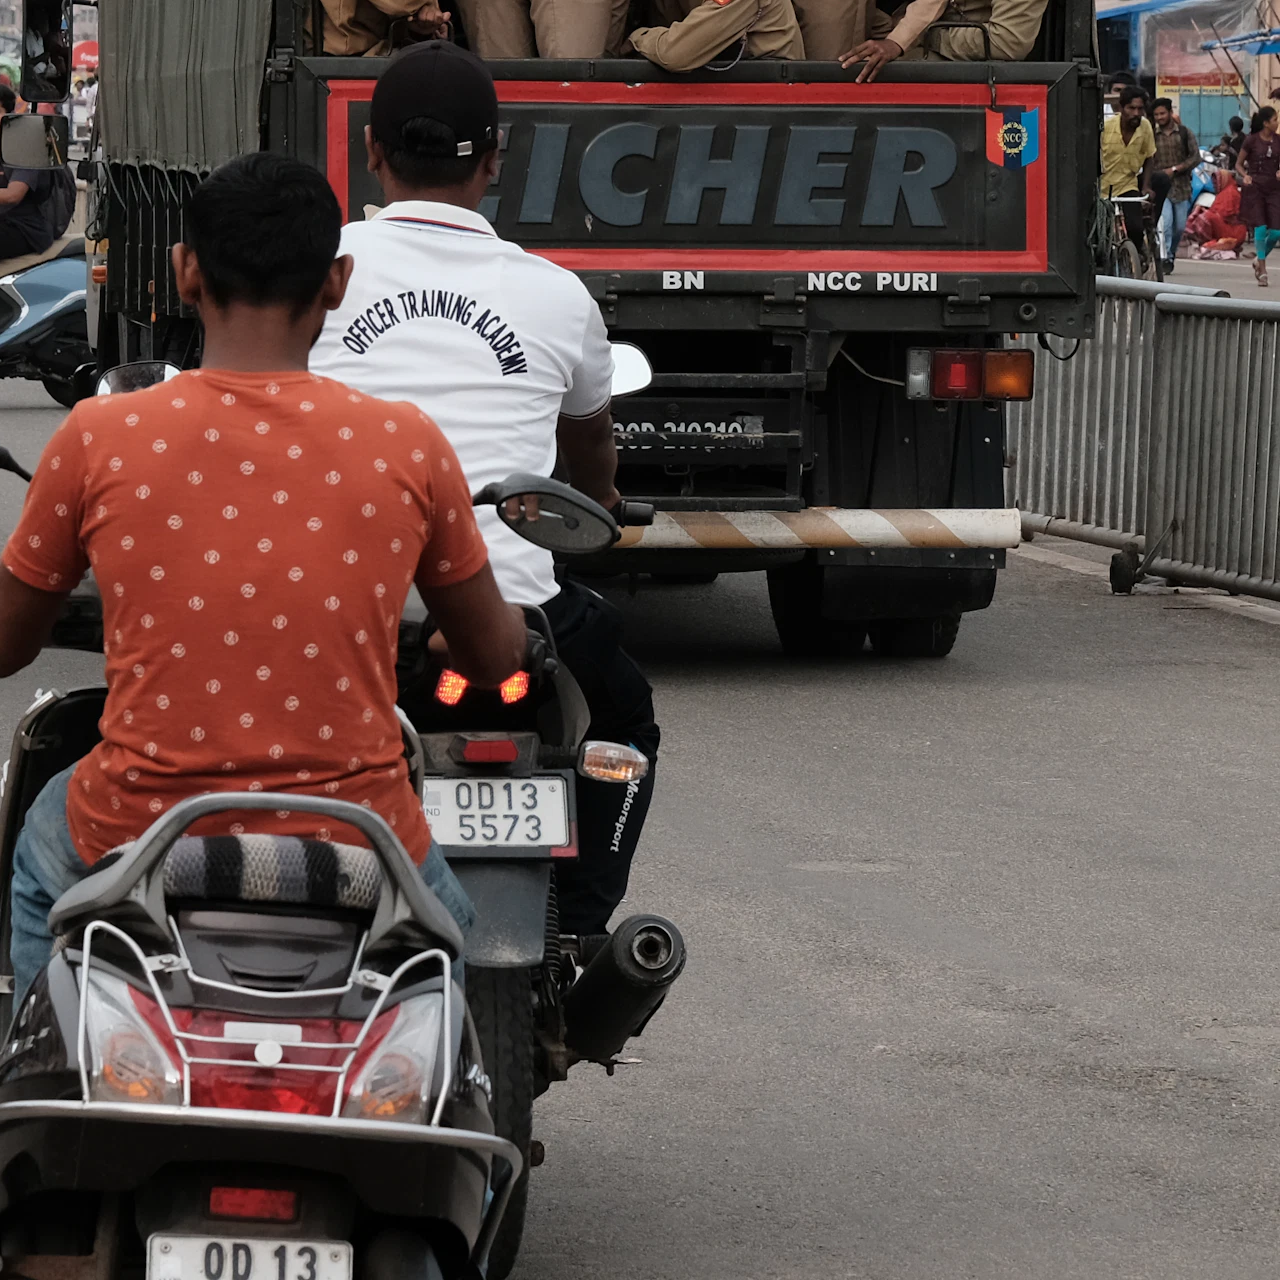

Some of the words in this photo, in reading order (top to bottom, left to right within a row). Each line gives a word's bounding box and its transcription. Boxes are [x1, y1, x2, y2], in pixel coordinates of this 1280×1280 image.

[1003, 133, 1023, 143] NCC
[662, 271, 705, 290] BN
[807, 272, 862, 291] NCC
[876, 272, 938, 291] PURI
[342, 297, 401, 355] OFFICER
[397, 289, 477, 327] TRAINING
[471, 308, 528, 377] ACADEMY
[455, 782, 539, 811] OD13
[459, 814, 542, 842] 5573
[609, 778, 641, 853] Motorsport
[204, 1242, 253, 1280] OD
[274, 1245, 318, 1280] 13
